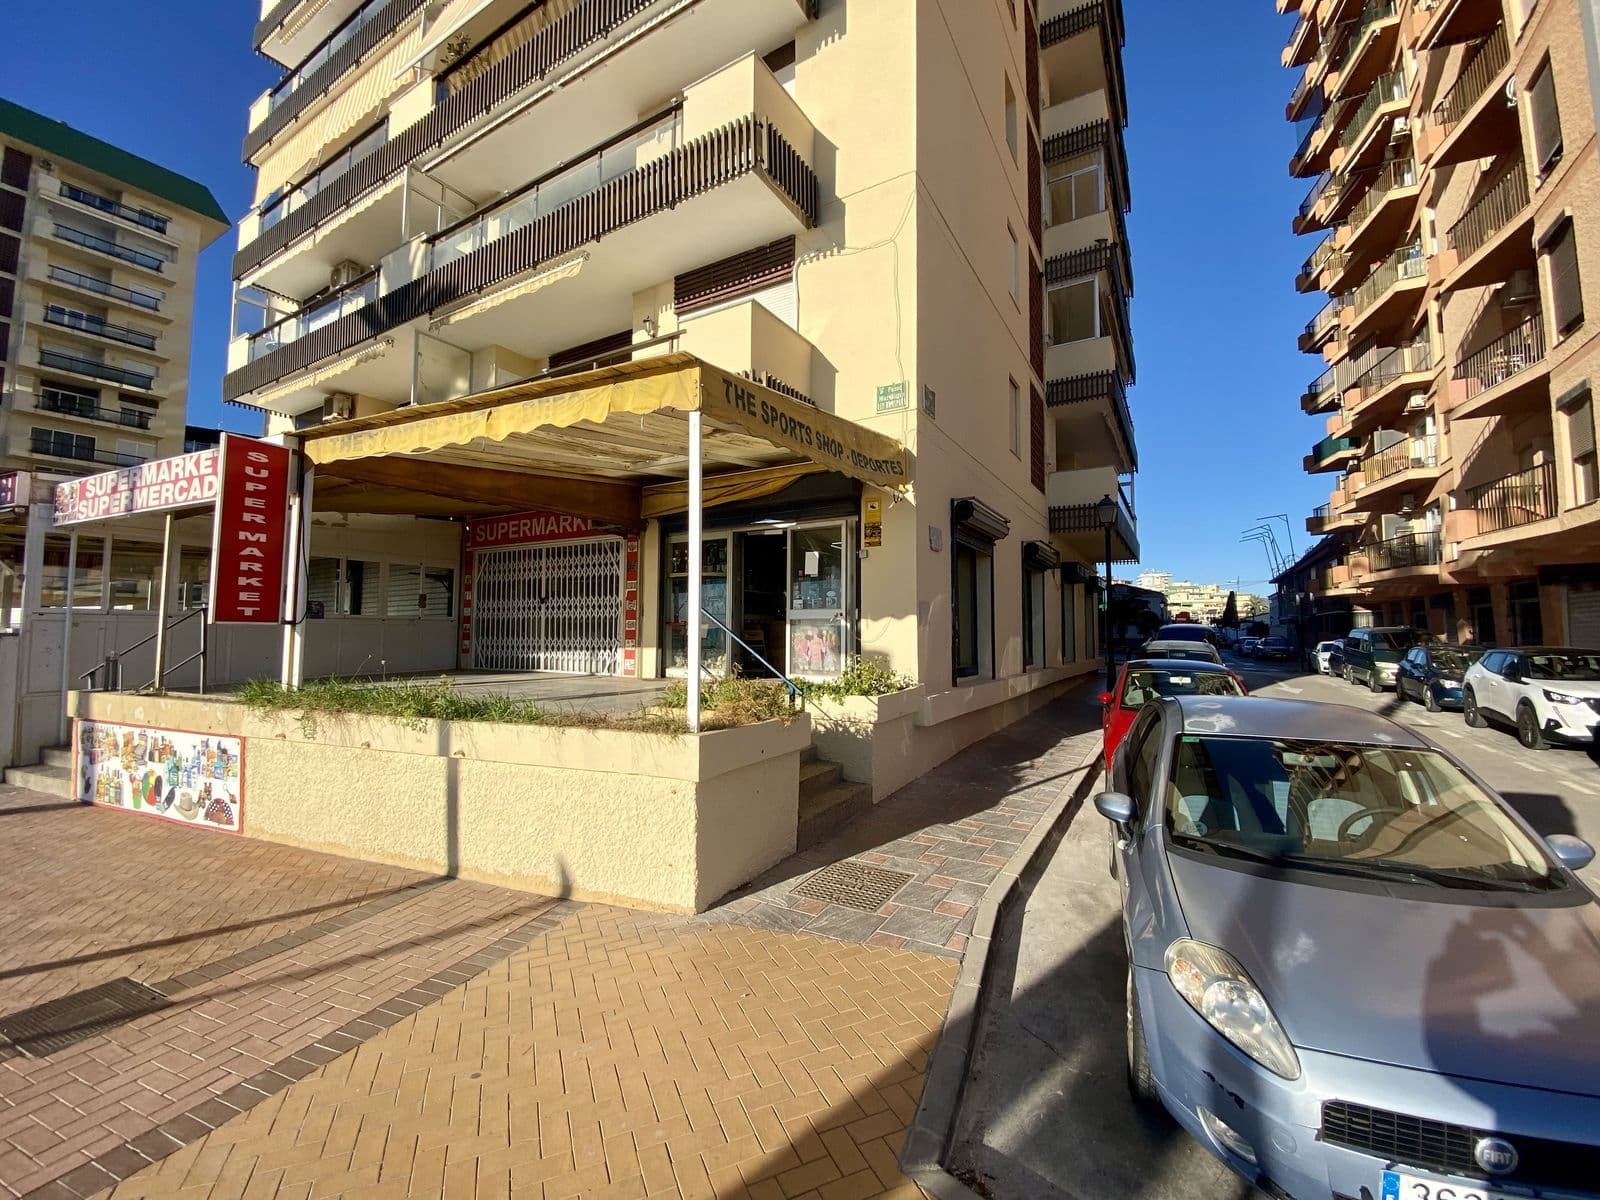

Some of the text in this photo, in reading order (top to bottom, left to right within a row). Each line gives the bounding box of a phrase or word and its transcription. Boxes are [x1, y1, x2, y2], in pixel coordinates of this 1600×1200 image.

[722, 378, 757, 417] THE
[761, 401, 813, 446] SPORTS
[816, 432, 844, 461] SHOP
[851, 449, 904, 476] DEPORTES
[78, 474, 217, 519] SUPERMERCAD
[237, 451, 270, 616] SUPERMARKET
[1483, 1149, 1511, 1165] FIAT
